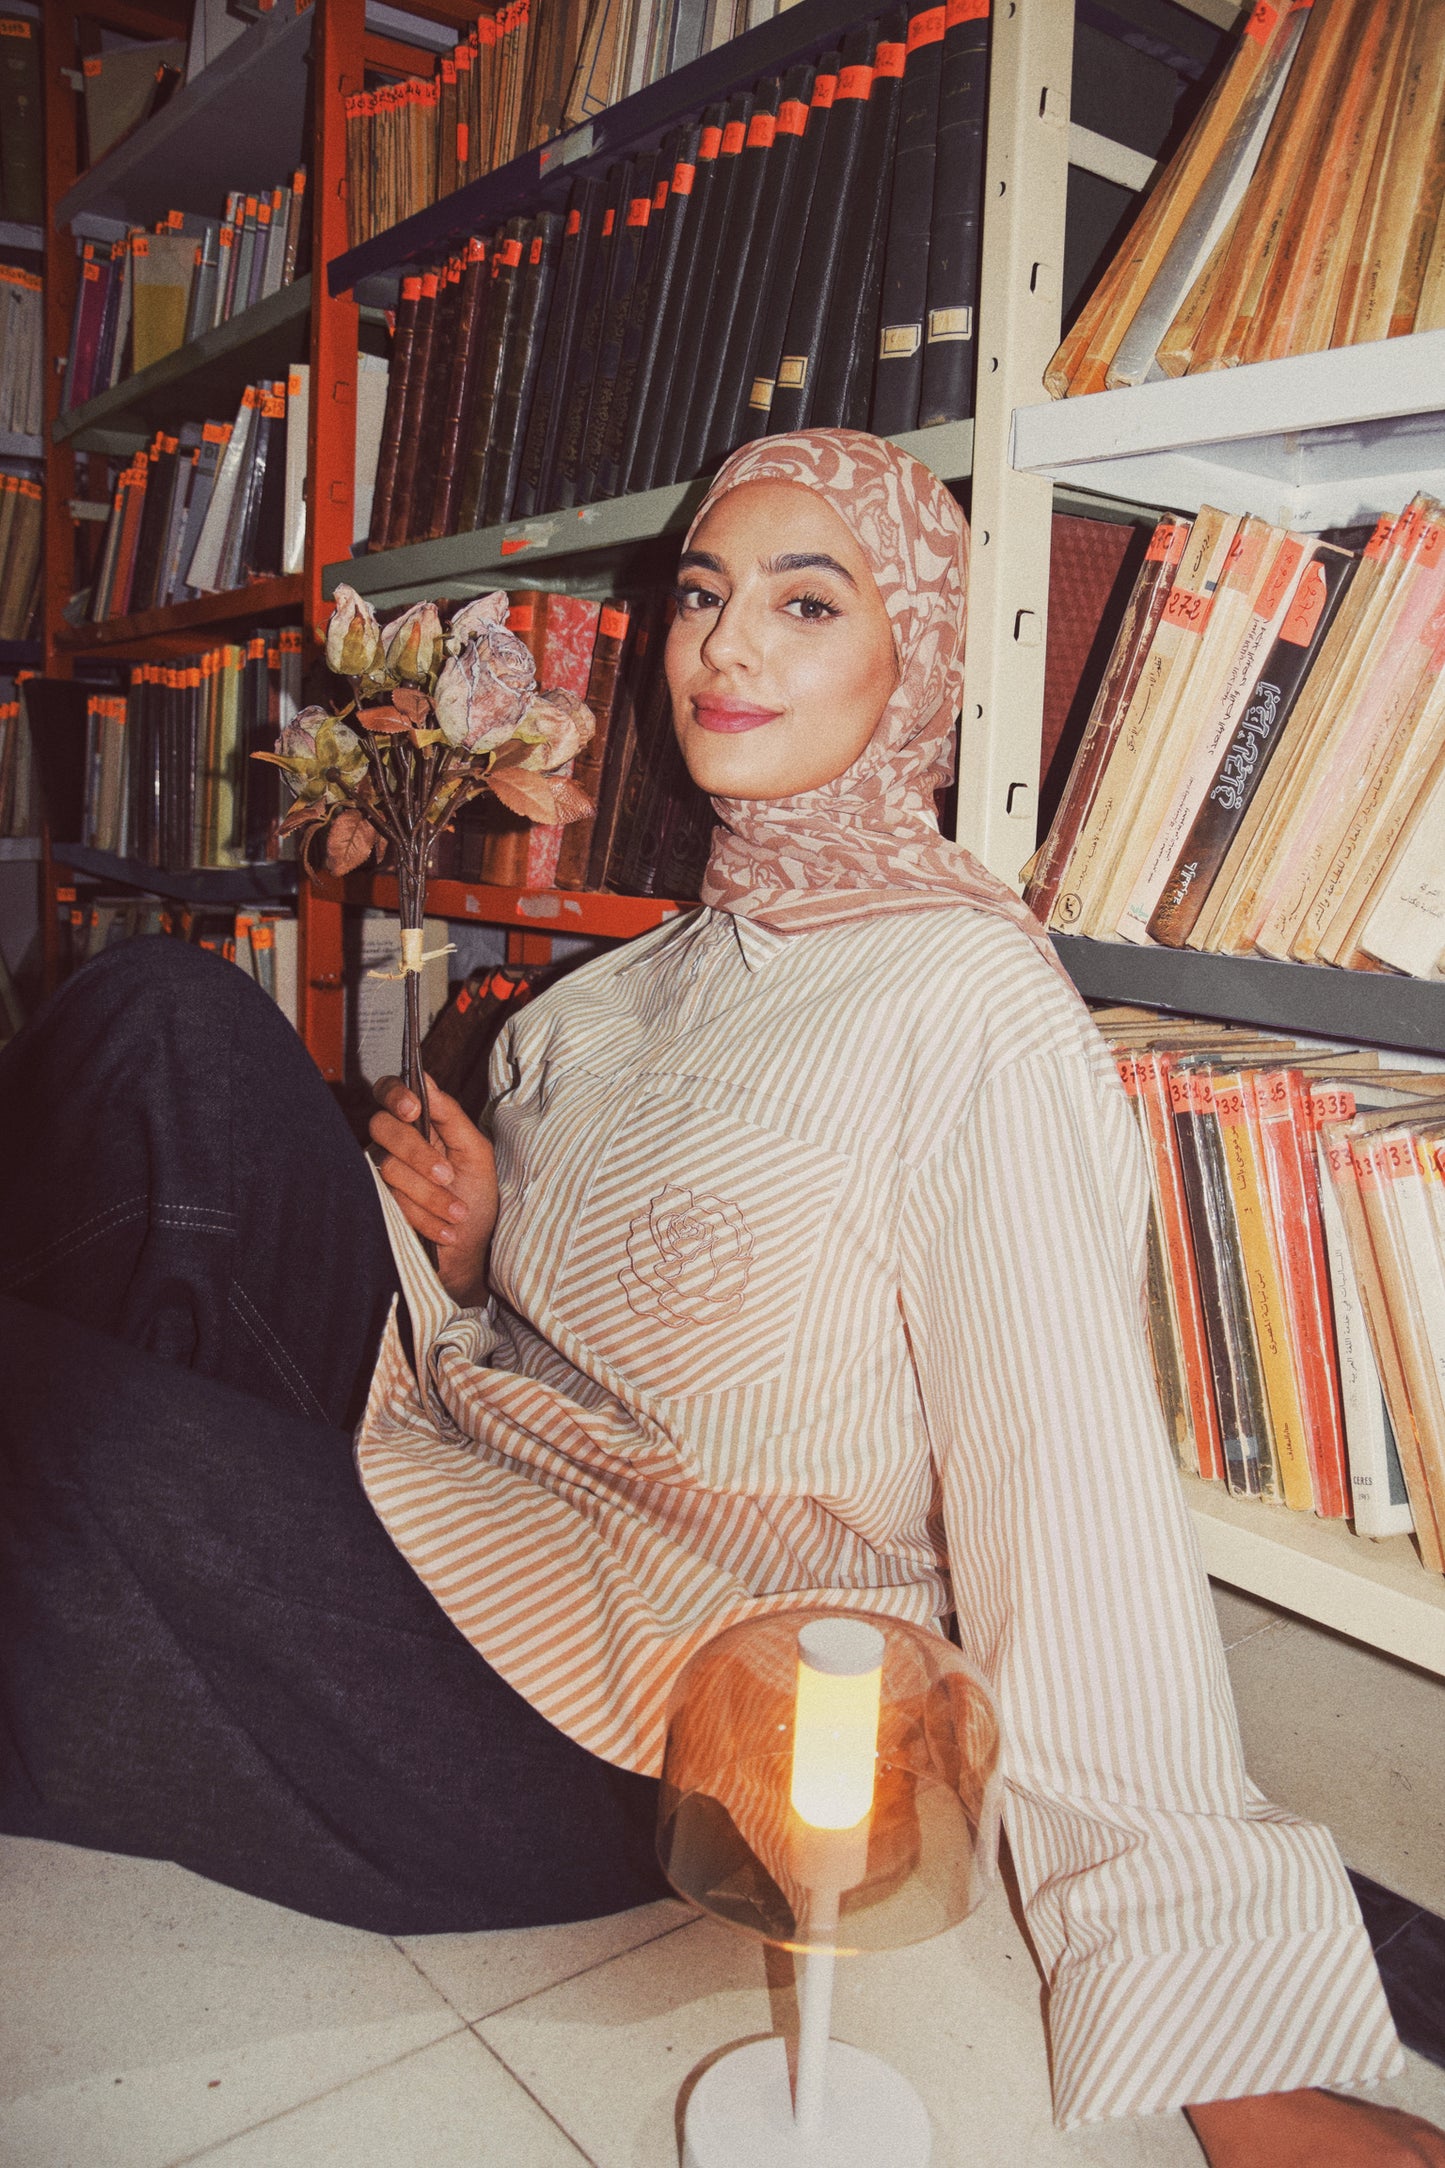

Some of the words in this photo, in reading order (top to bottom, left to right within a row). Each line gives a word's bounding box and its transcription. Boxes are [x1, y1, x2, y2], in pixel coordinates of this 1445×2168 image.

[1344, 1338, 1352, 1354] اللغة
[1348, 1358, 1358, 1384] العربية
[1353, 1476, 1373, 1486] CERES
